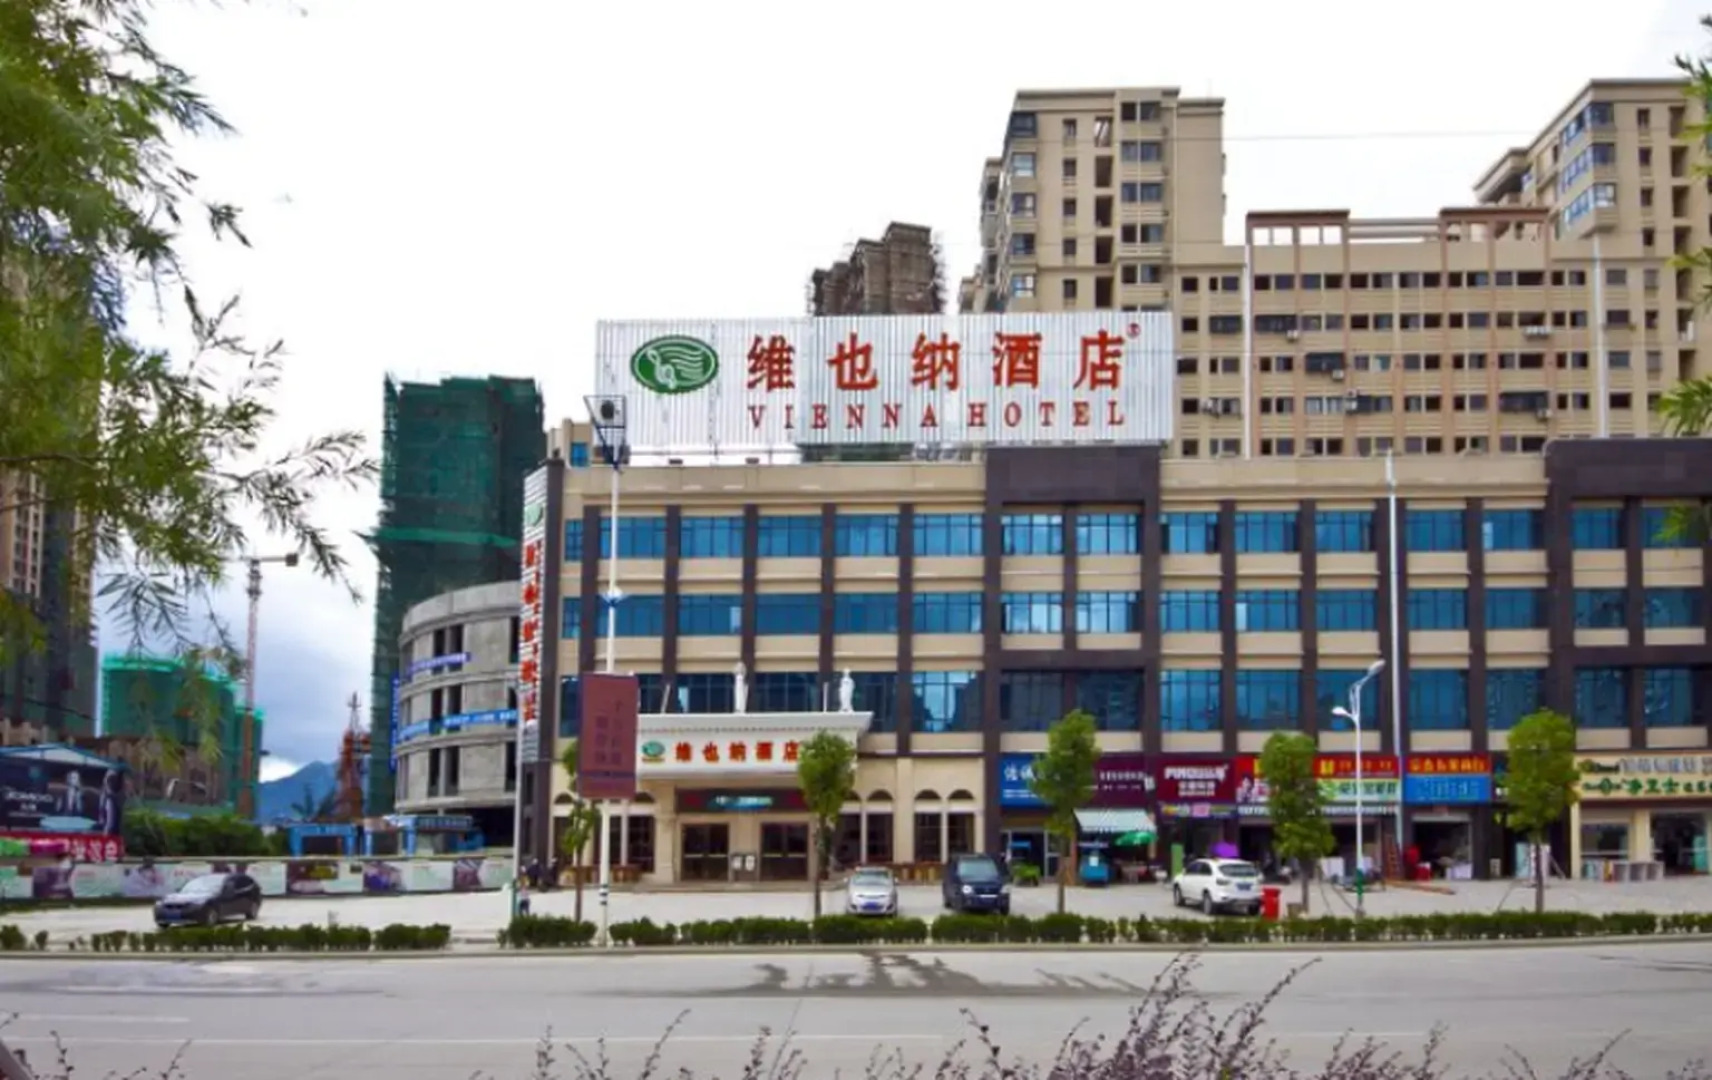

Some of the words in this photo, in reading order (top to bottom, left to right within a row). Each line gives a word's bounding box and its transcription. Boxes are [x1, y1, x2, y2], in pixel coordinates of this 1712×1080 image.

[747, 331, 1125, 392] 维也纳酒店
[747, 402, 938, 430] VIENNA
[967, 400, 1125, 427] HOTEL
